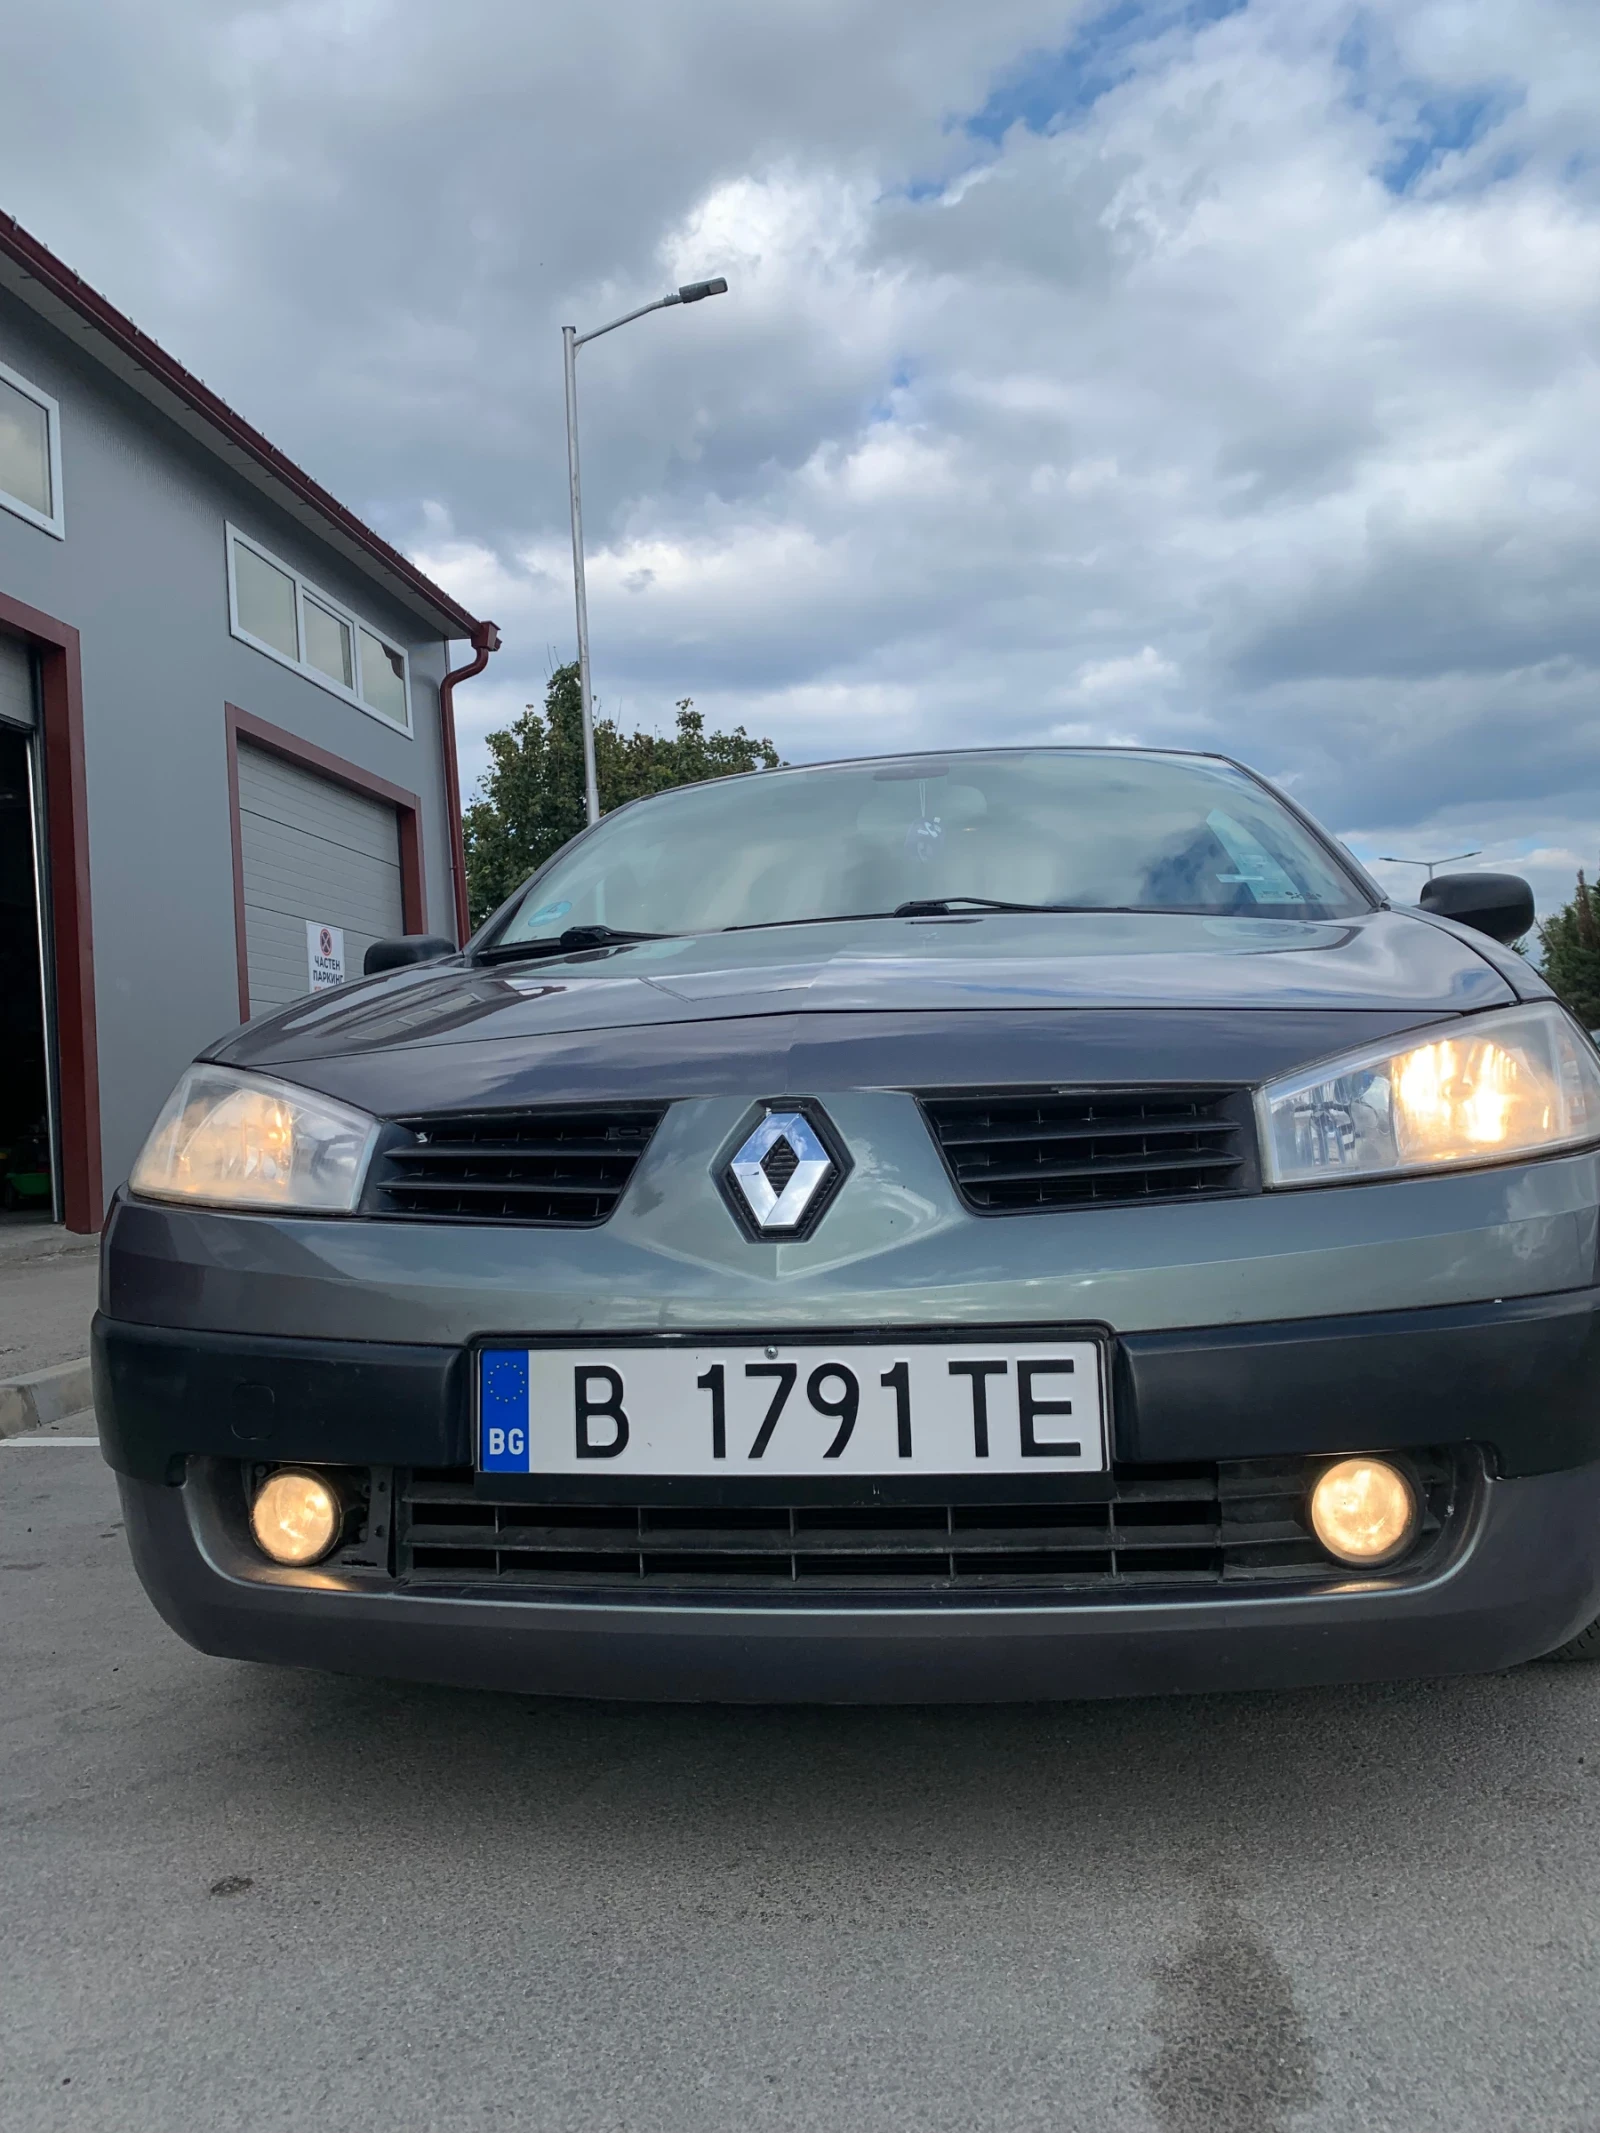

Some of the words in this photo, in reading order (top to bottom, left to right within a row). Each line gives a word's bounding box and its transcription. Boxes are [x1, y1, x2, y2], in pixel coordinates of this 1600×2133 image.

[314, 955, 341, 971] ЧАСТЕН
[313, 969, 343, 985] ПАРКИНГ
[574, 1364, 630, 1459] B
[697, 1361, 912, 1459] 1791
[949, 1359, 1082, 1458] TE
[488, 1427, 524, 1455] BG
